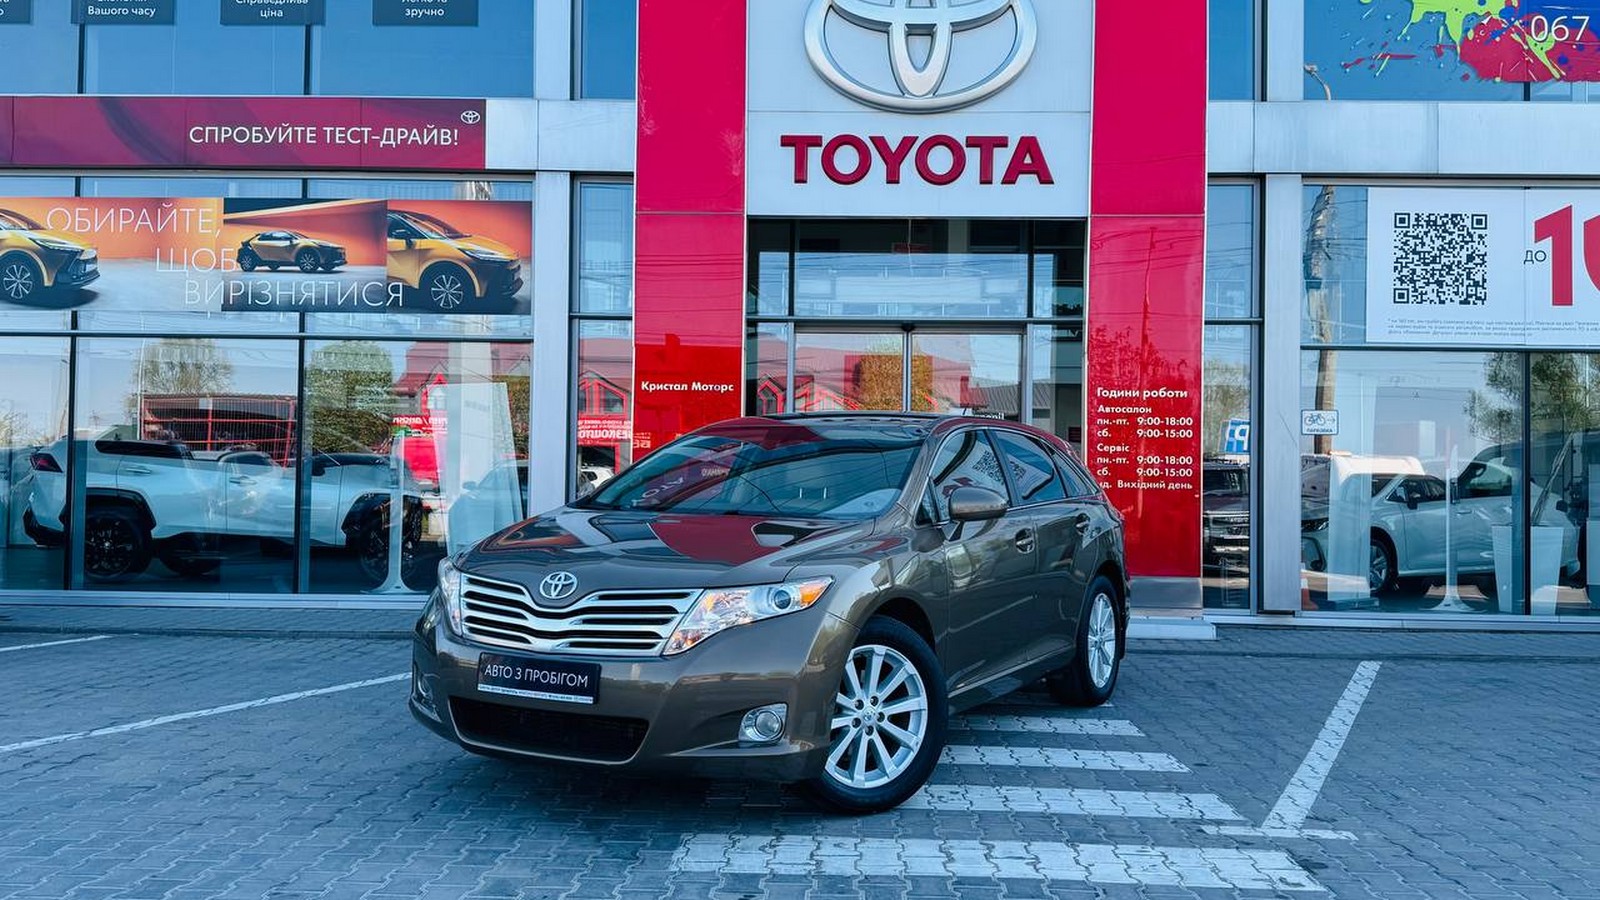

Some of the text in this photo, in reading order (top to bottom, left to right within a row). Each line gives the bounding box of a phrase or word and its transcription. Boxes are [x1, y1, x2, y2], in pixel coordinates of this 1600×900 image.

[88, 6, 156, 18] Вашого часу
[260, 8, 283, 18] ціна
[405, 8, 445, 18] зручно
[1531, 16, 1590, 41] 067
[189, 123, 459, 147] СПРОБУЙТЕ ТЕСТ-ДРАЙВ!
[780, 134, 1054, 185] TOYOTA
[46, 202, 220, 238] ОБИРАЙТЕ,
[156, 248, 237, 276] ЩОБ
[185, 280, 403, 306] ВИРІЗНЯТИСЯ
[641, 381, 734, 393] Кристал Моторс
[1097, 387, 1188, 400] Години роботи
[1097, 405, 1152, 414] Автосалон
[1097, 416, 1194, 426] пн.-пт. 9:00-18:00
[1097, 428, 1193, 438] сб. 9:00-15:00
[1097, 443, 1130, 453] Сервіс
[1097, 455, 1193, 465] пн.-пт. 9:00-18:00
[1097, 466, 1193, 477] сб. 9:00-15:00
[1117, 479, 1166, 490] Вихідний
[1168, 481, 1193, 490] день
[484, 664, 513, 679] АВТО
[524, 668, 589, 688] ПРОБІГОМ
